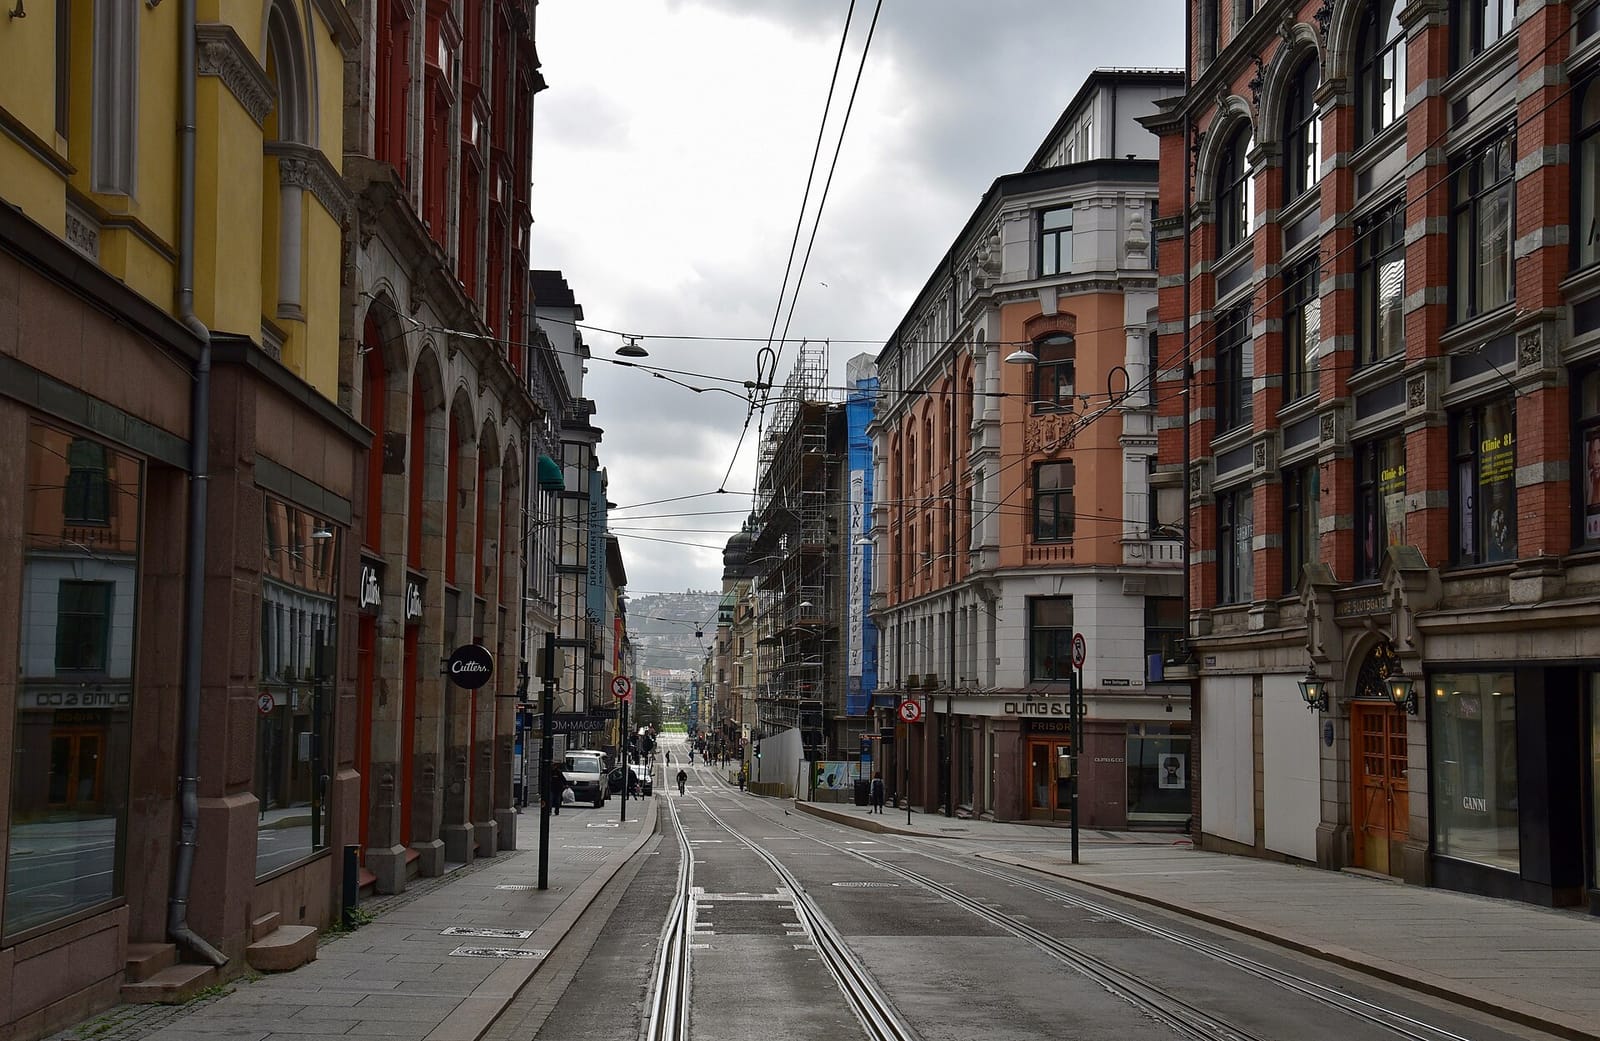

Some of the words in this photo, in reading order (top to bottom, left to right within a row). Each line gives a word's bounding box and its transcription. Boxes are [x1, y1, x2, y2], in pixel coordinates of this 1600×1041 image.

[1481, 437, 1501, 453] Clinic
[1503, 432, 1512, 446] 81
[1051, 703, 1063, 715] &
[1463, 796, 1487, 812] GANNI
